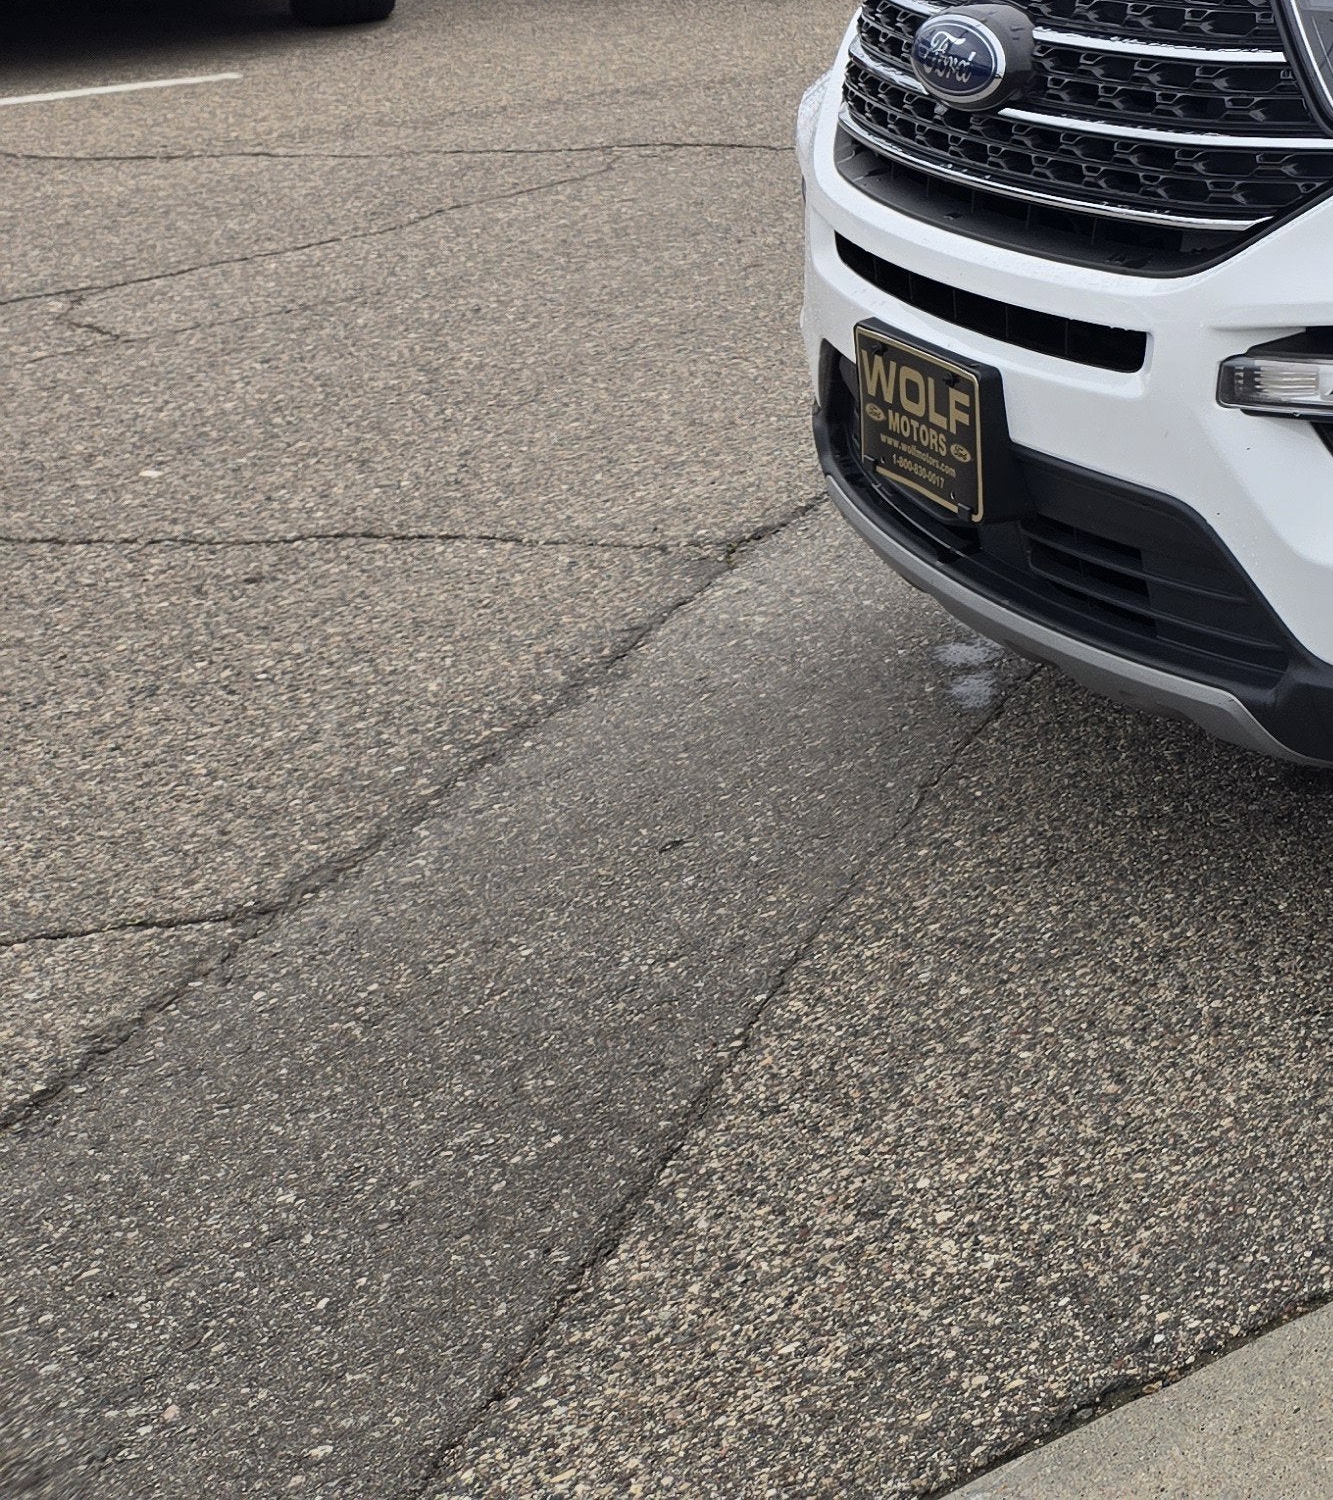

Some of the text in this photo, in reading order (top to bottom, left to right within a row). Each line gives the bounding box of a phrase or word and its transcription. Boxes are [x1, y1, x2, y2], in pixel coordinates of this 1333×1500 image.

[922, 30, 977, 83] Ford
[861, 349, 970, 435] WOLF
[888, 409, 948, 457] MOTORS
